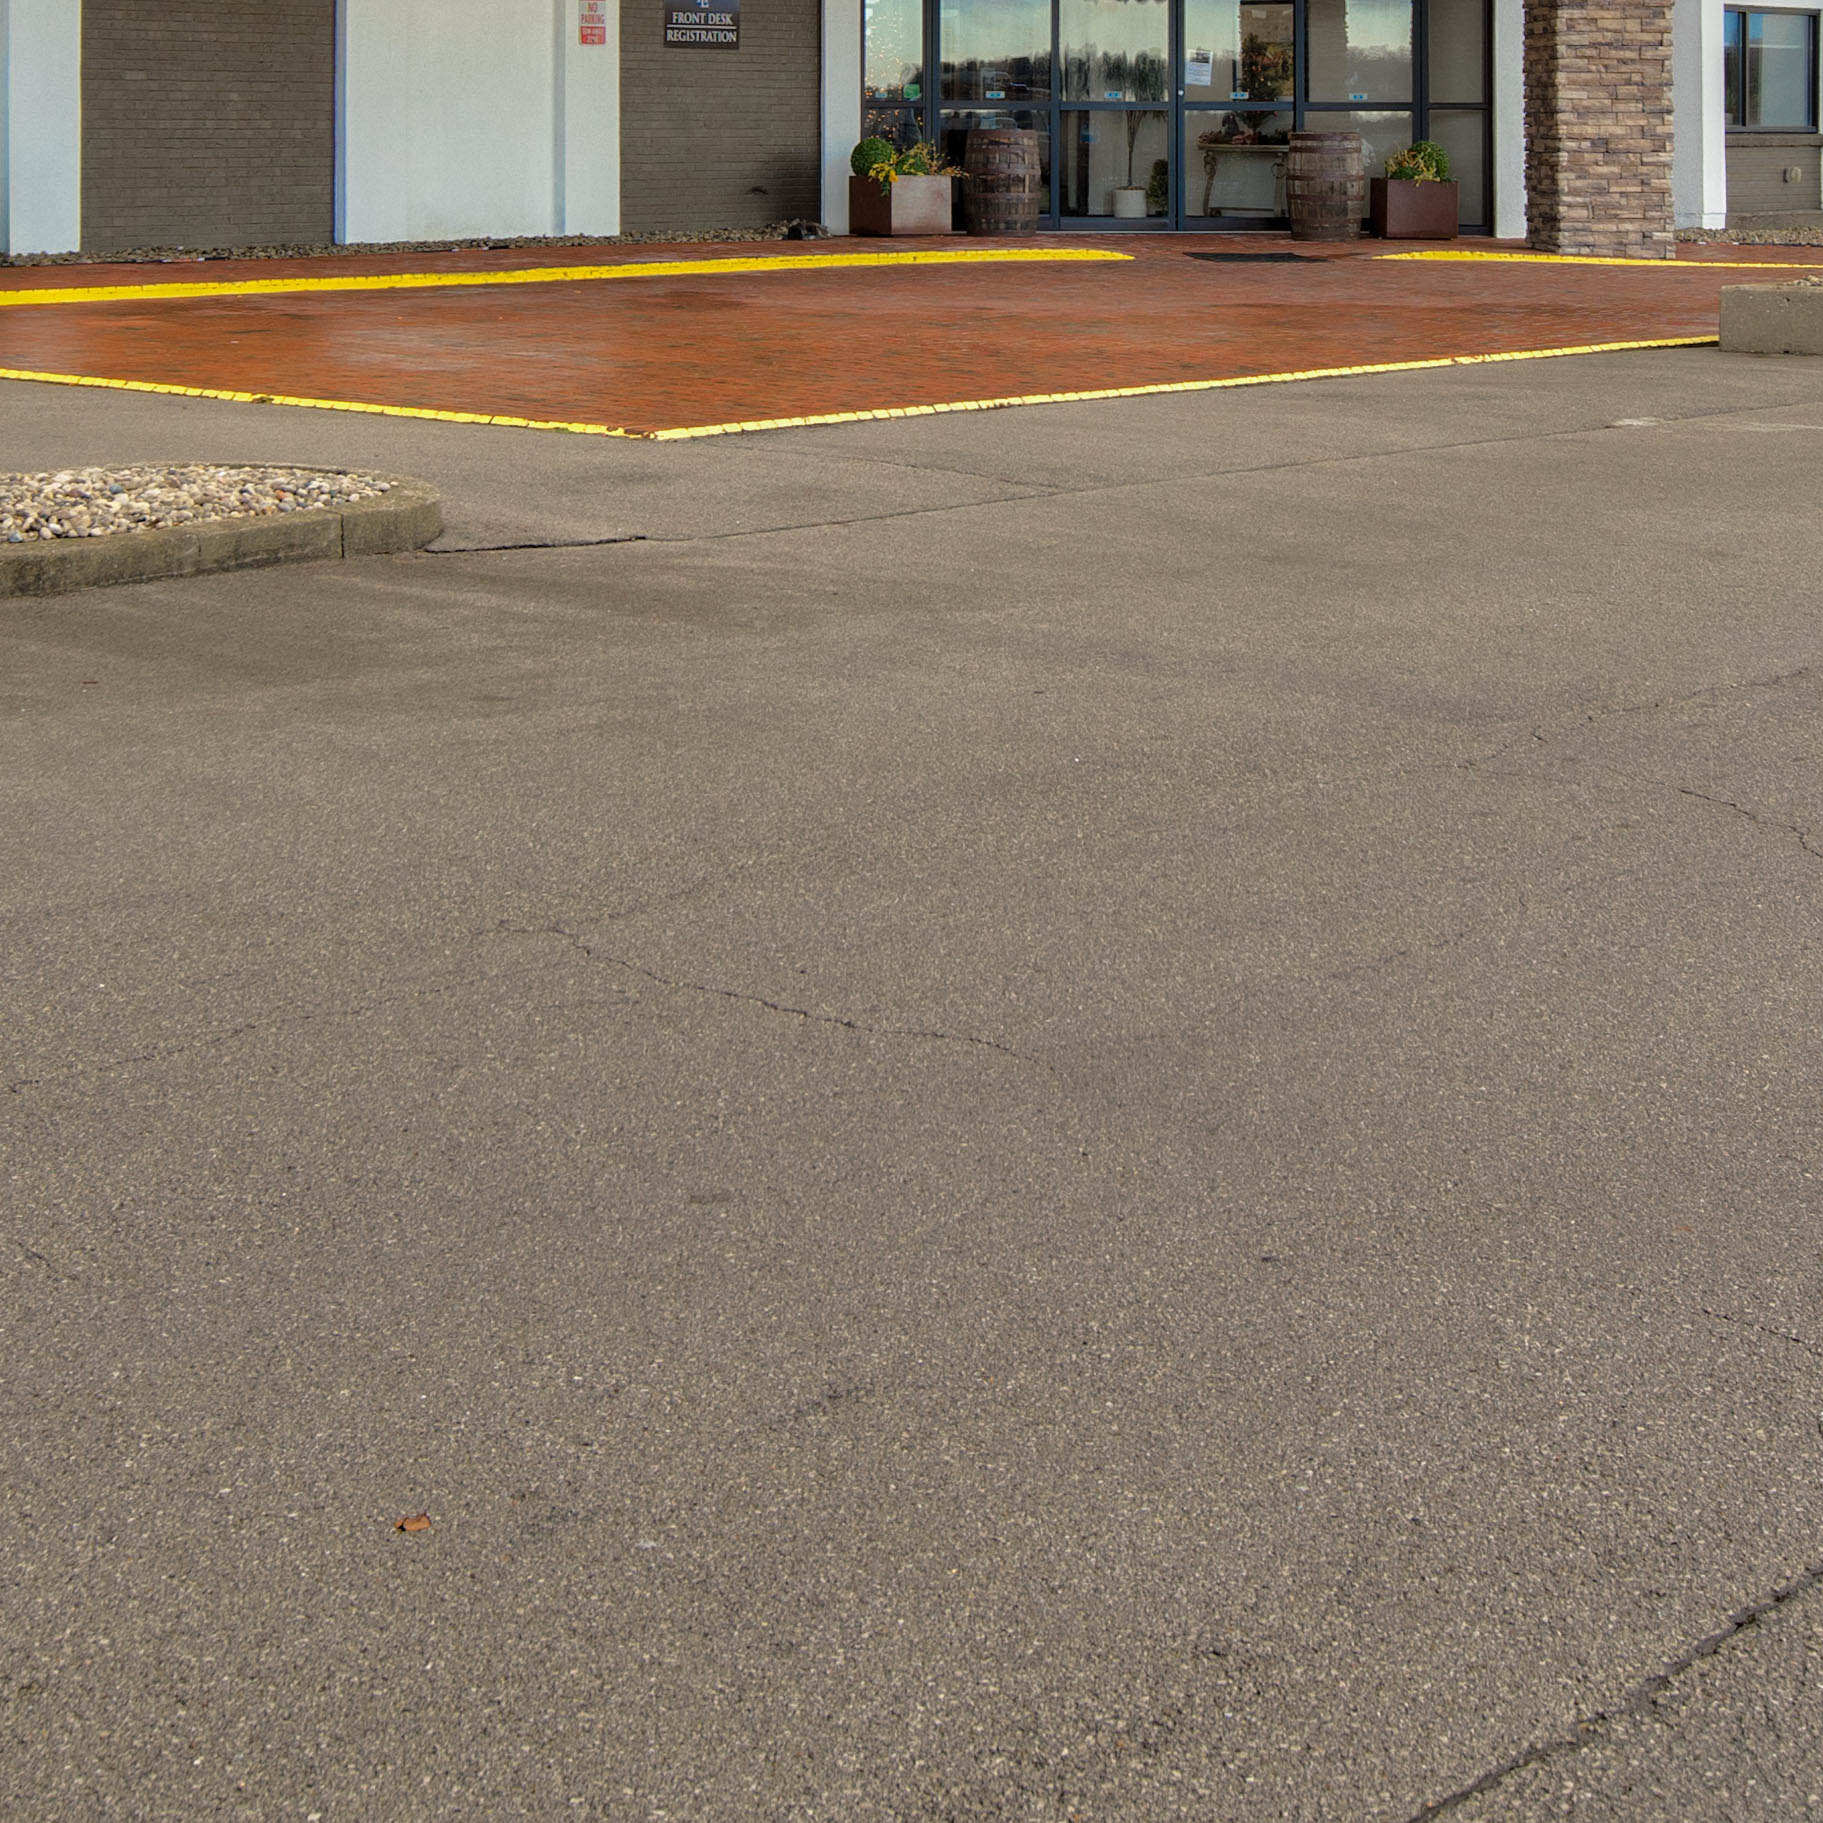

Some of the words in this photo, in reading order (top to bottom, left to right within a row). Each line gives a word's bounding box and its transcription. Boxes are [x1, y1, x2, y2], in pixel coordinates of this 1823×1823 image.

[587, 2, 598, 13] NO
[581, 14, 605, 24] PARKING
[672, 11, 706, 24] FRONT
[708, 13, 733, 25] DESK
[666, 29, 737, 43] REGISTRATION
